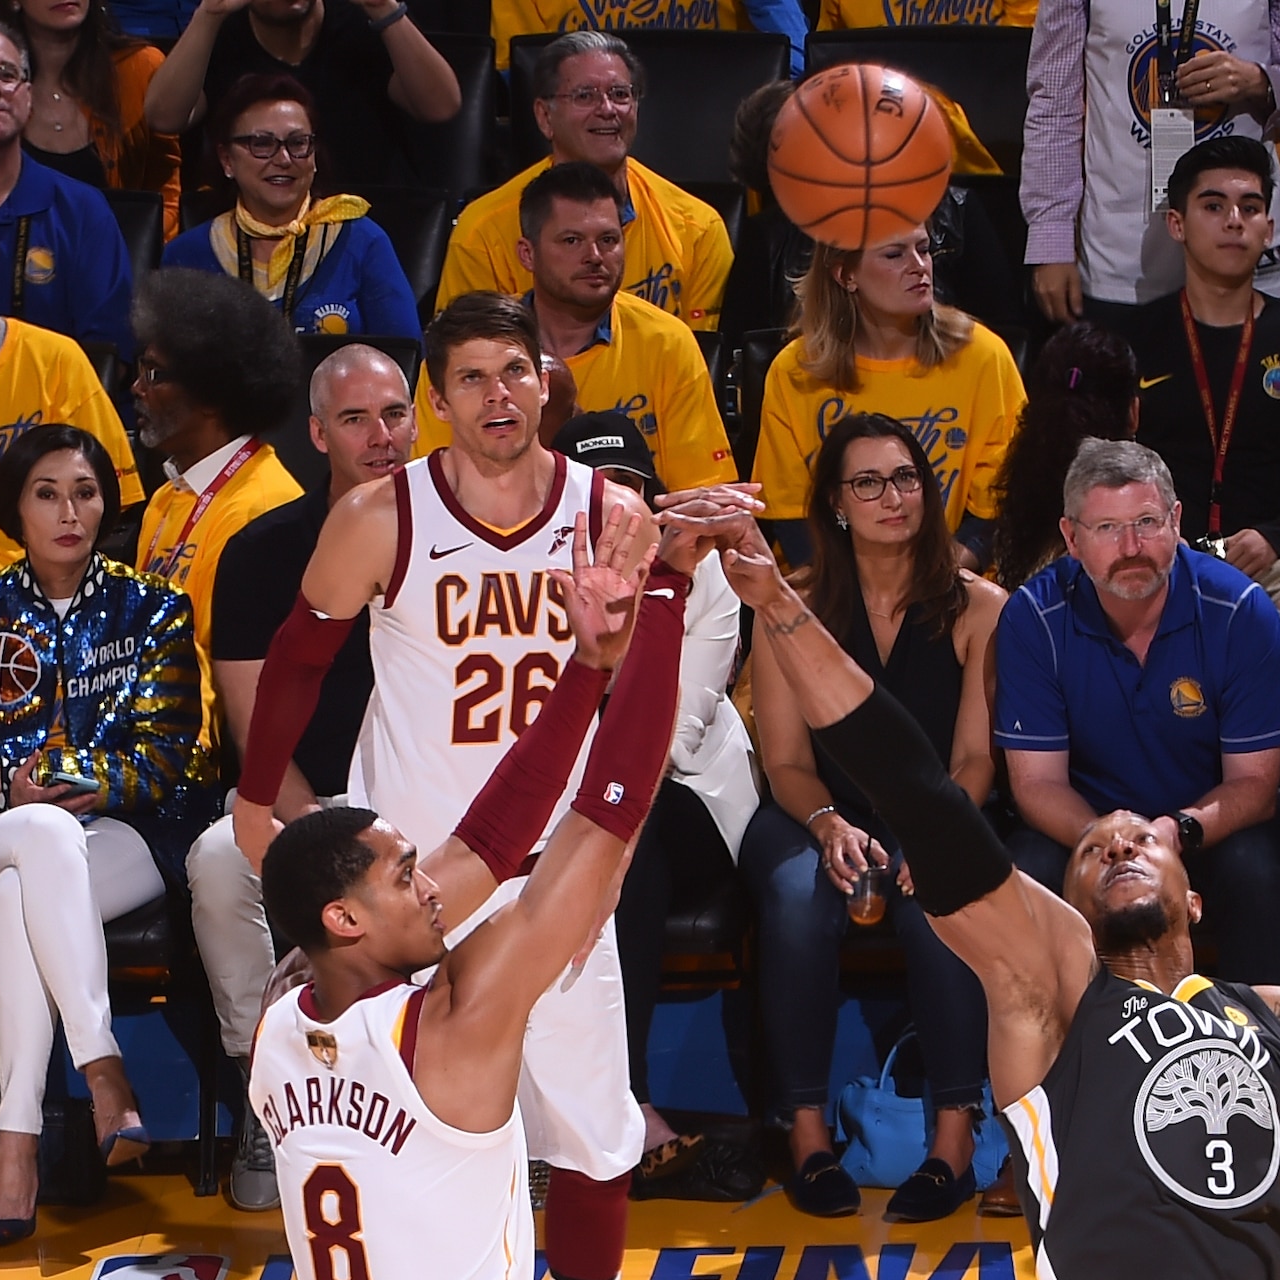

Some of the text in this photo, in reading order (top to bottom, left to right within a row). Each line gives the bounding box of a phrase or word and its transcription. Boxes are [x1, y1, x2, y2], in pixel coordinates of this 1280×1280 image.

[1195, 19, 1238, 53] STATE
[436, 571, 575, 648] CAVS
[84, 636, 135, 669] WORLD
[451, 652, 560, 745] 26
[1108, 1001, 1271, 1070] TOWN
[1122, 996, 1148, 1018] The
[263, 1076, 418, 1156] CLARKSON
[1205, 1139, 1236, 1195] 3
